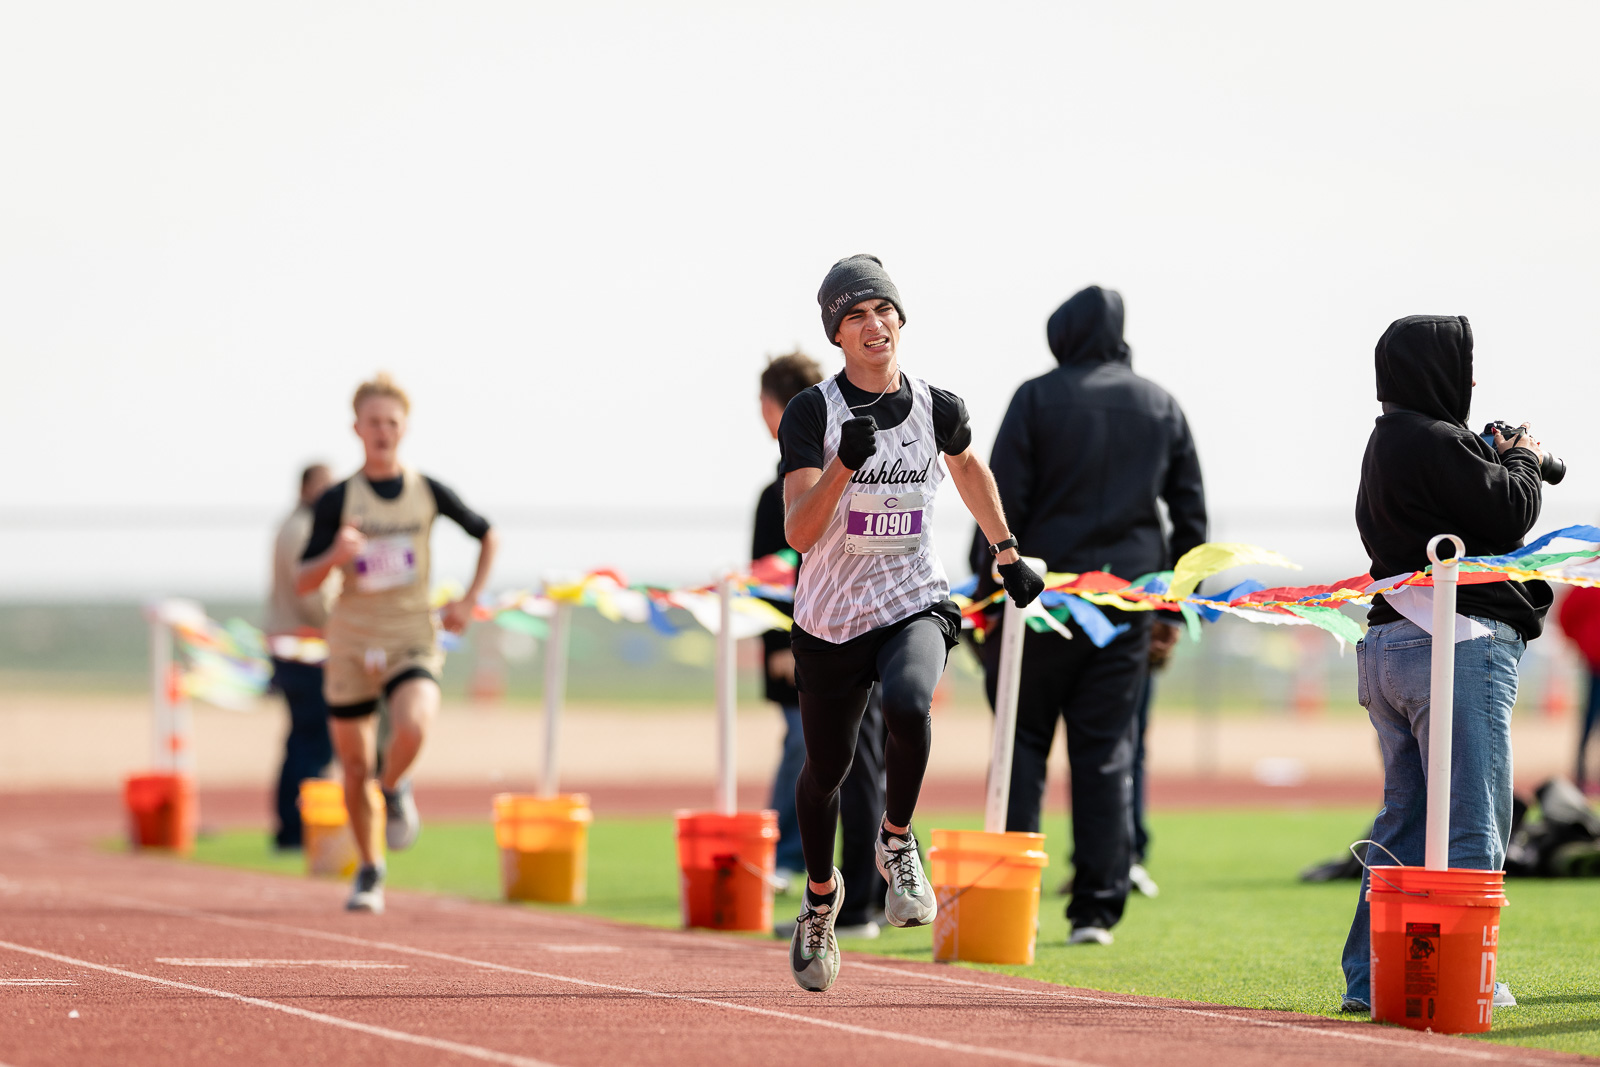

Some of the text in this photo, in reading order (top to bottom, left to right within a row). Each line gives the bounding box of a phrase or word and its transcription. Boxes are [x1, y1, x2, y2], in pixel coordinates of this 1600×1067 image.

[828, 292, 852, 317] ALPHA
[849, 457, 932, 485] ushland
[883, 497, 899, 509] C
[862, 512, 912, 536] 1090
